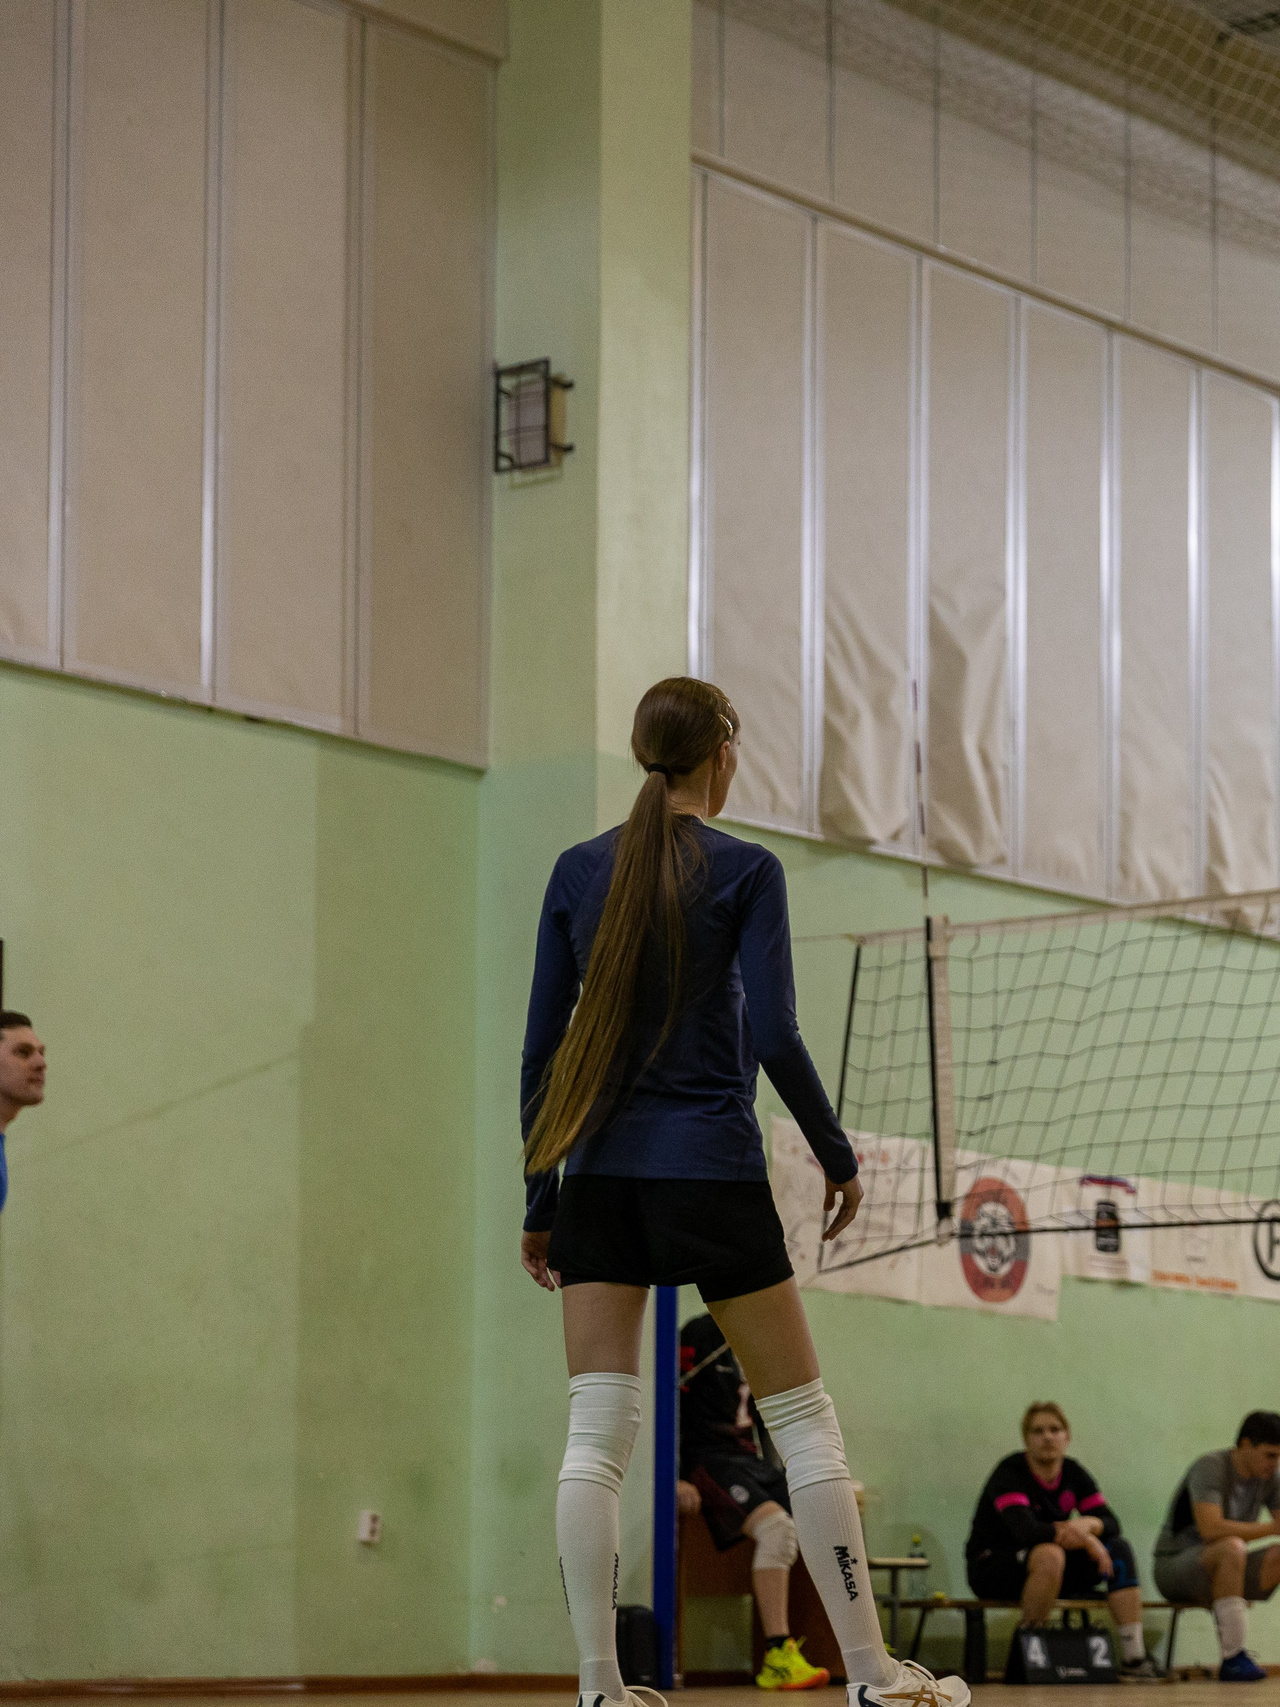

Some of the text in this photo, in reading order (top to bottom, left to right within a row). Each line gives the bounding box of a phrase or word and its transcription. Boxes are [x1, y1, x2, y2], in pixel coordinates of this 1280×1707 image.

[833, 1545, 859, 1602] MIKASA
[1027, 1635, 1112, 1669] 4 2
